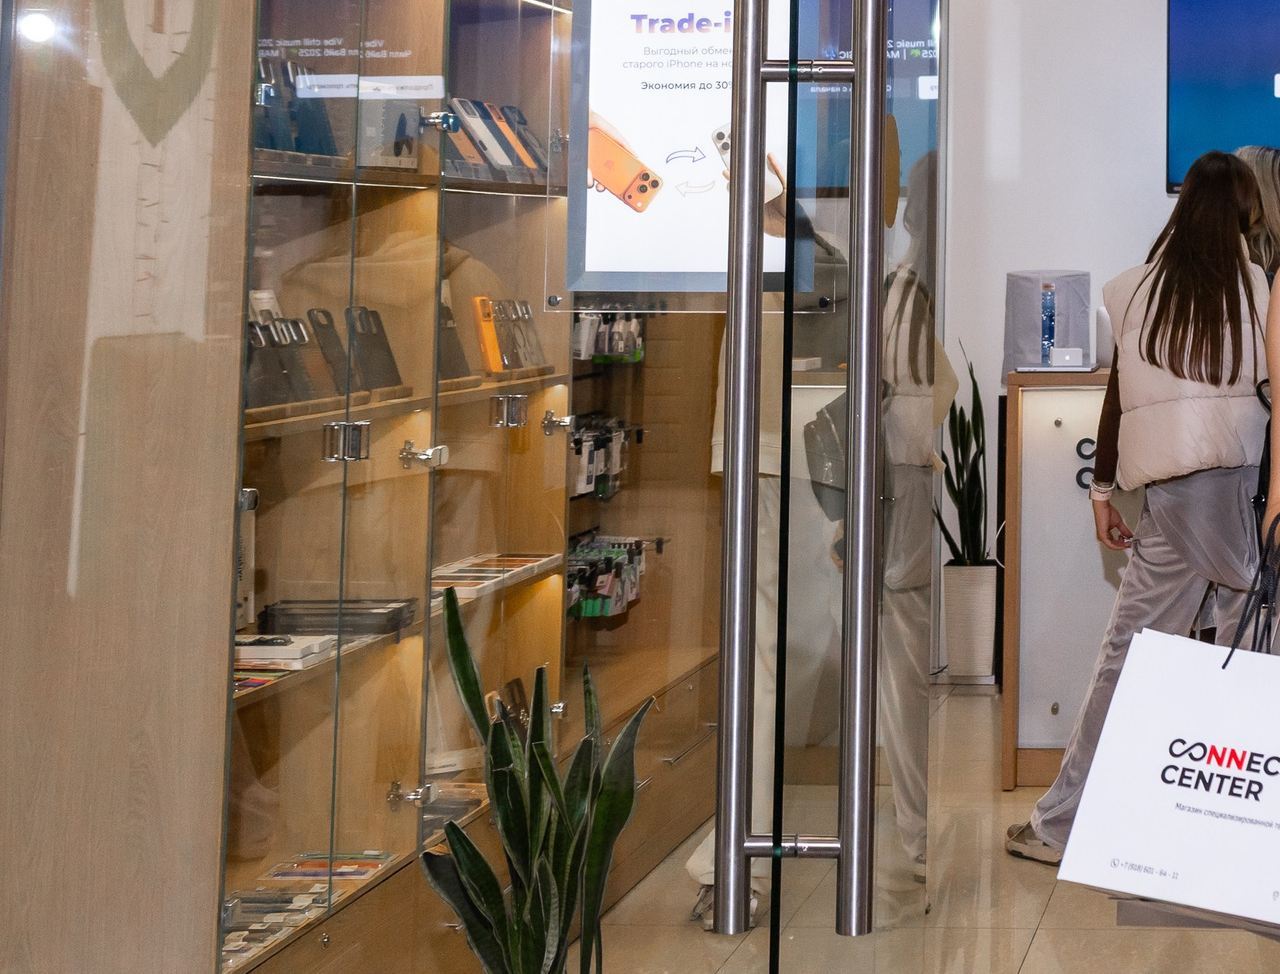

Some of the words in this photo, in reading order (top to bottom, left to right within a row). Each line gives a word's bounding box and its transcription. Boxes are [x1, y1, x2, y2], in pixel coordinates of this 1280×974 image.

[630, 10, 732, 34] Trade-i
[643, 46, 698, 56] Выгодный
[622, 60, 664, 70] старого
[666, 59, 703, 68] iPhone
[641, 81, 696, 90] Экономия
[699, 82, 712, 90] до
[1160, 764, 1264, 802] CENTER
[1175, 802, 1202, 814] Магазин
[1204, 808, 1274, 829] специализированной
